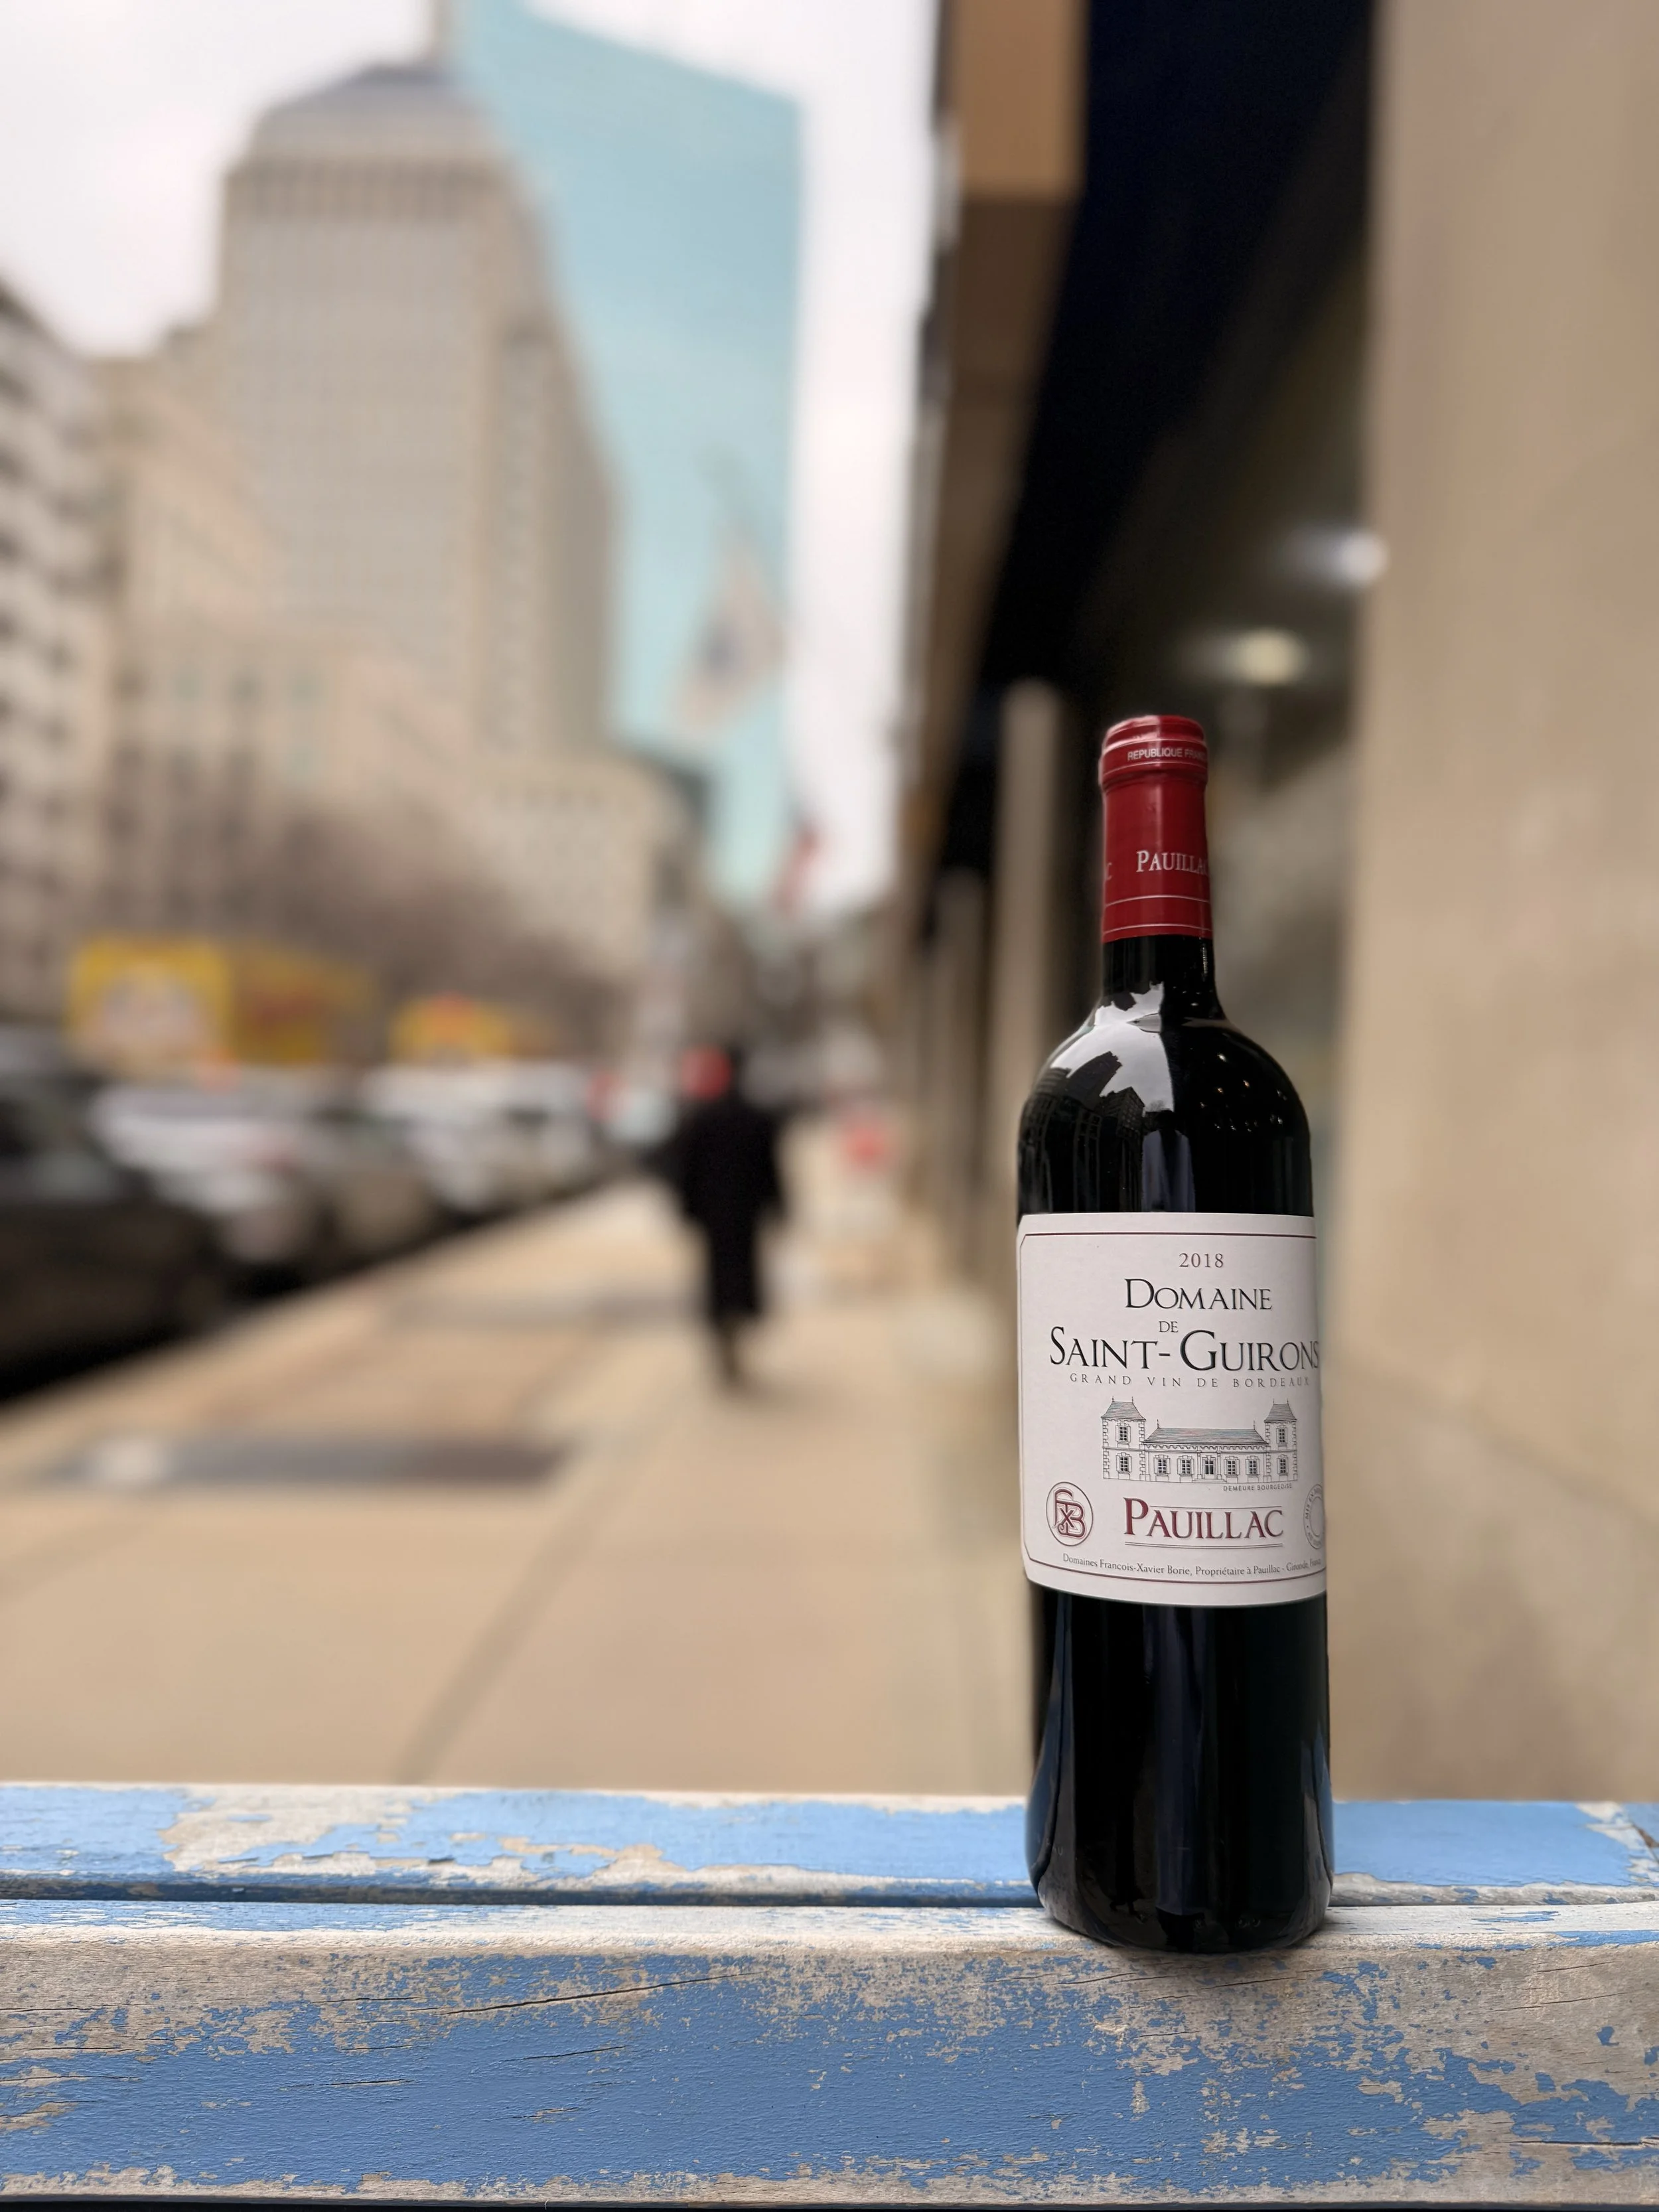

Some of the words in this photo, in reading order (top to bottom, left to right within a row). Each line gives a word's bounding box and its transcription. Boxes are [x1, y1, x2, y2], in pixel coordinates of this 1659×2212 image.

[1179, 1252, 1224, 1268] 2018
[1124, 1278, 1273, 1310] DOMAINE
[1159, 1321, 1179, 1333] DE
[1050, 1326, 1319, 1372] SAINT-GUIRONS
[1070, 1373, 1132, 1386] GRAND
[1147, 1376, 1181, 1387] VIN
[1197, 1378, 1218, 1388] DE
[1233, 1377, 1311, 1388] BORDEAUX
[1123, 1497, 1283, 1539] PAUILLAC
[1063, 1553, 1098, 1567] Domaines
[1100, 1559, 1165, 1574] Francois-Xavier
[1167, 1565, 1192, 1576] Borie,
[1196, 1566, 1245, 1577] Propriétaire
[1247, 1566, 1252, 1575] à
[1253, 1564, 1280, 1574] Pauillac
